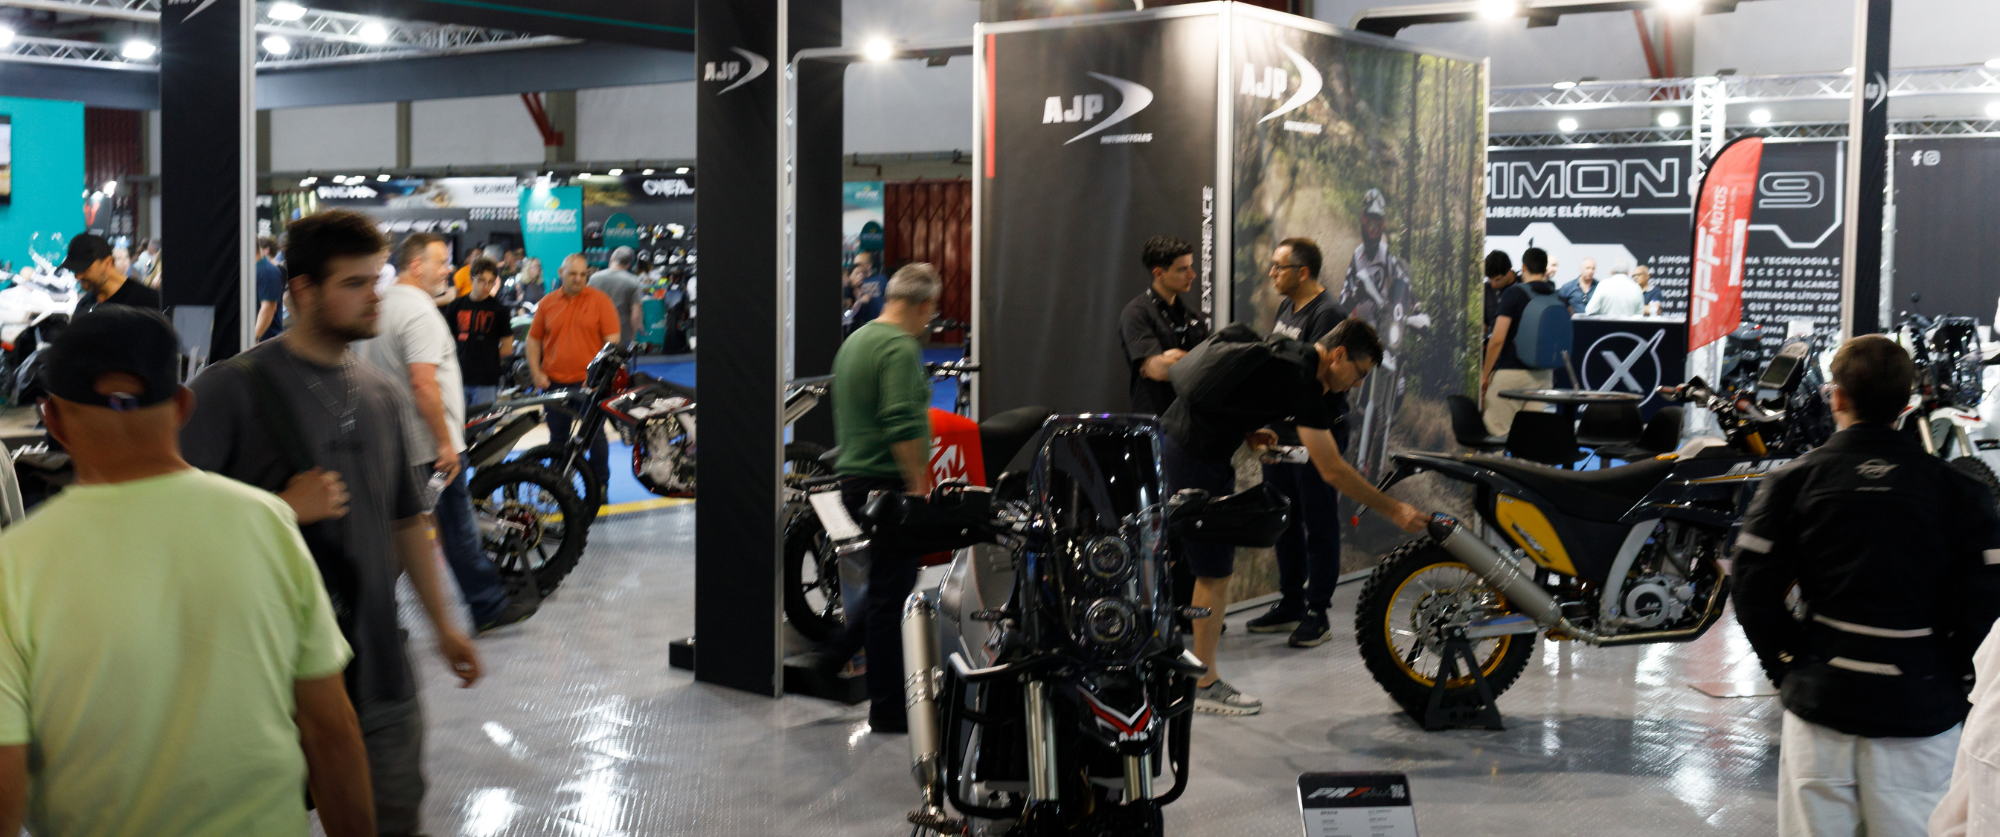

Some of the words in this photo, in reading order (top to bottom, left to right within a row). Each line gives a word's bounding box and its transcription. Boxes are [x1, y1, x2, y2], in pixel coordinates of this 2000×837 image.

[703, 61, 741, 81] AJP
[1240, 63, 1287, 100] AJP
[1042, 94, 1104, 124] AJP
[1486, 157, 1680, 200] IMON
[1486, 205, 1556, 219] LIBERDADE
[1201, 185, 1214, 315] EXPERIENCE
[1763, 256, 1829, 266] TECNOLOGIA
[1756, 280, 1773, 288] KM
[1774, 280, 1789, 288] DE
[1791, 280, 1840, 289] ALCANCE
[1748, 302, 1771, 311] QUE
[1774, 303, 1814, 312] PODEM
